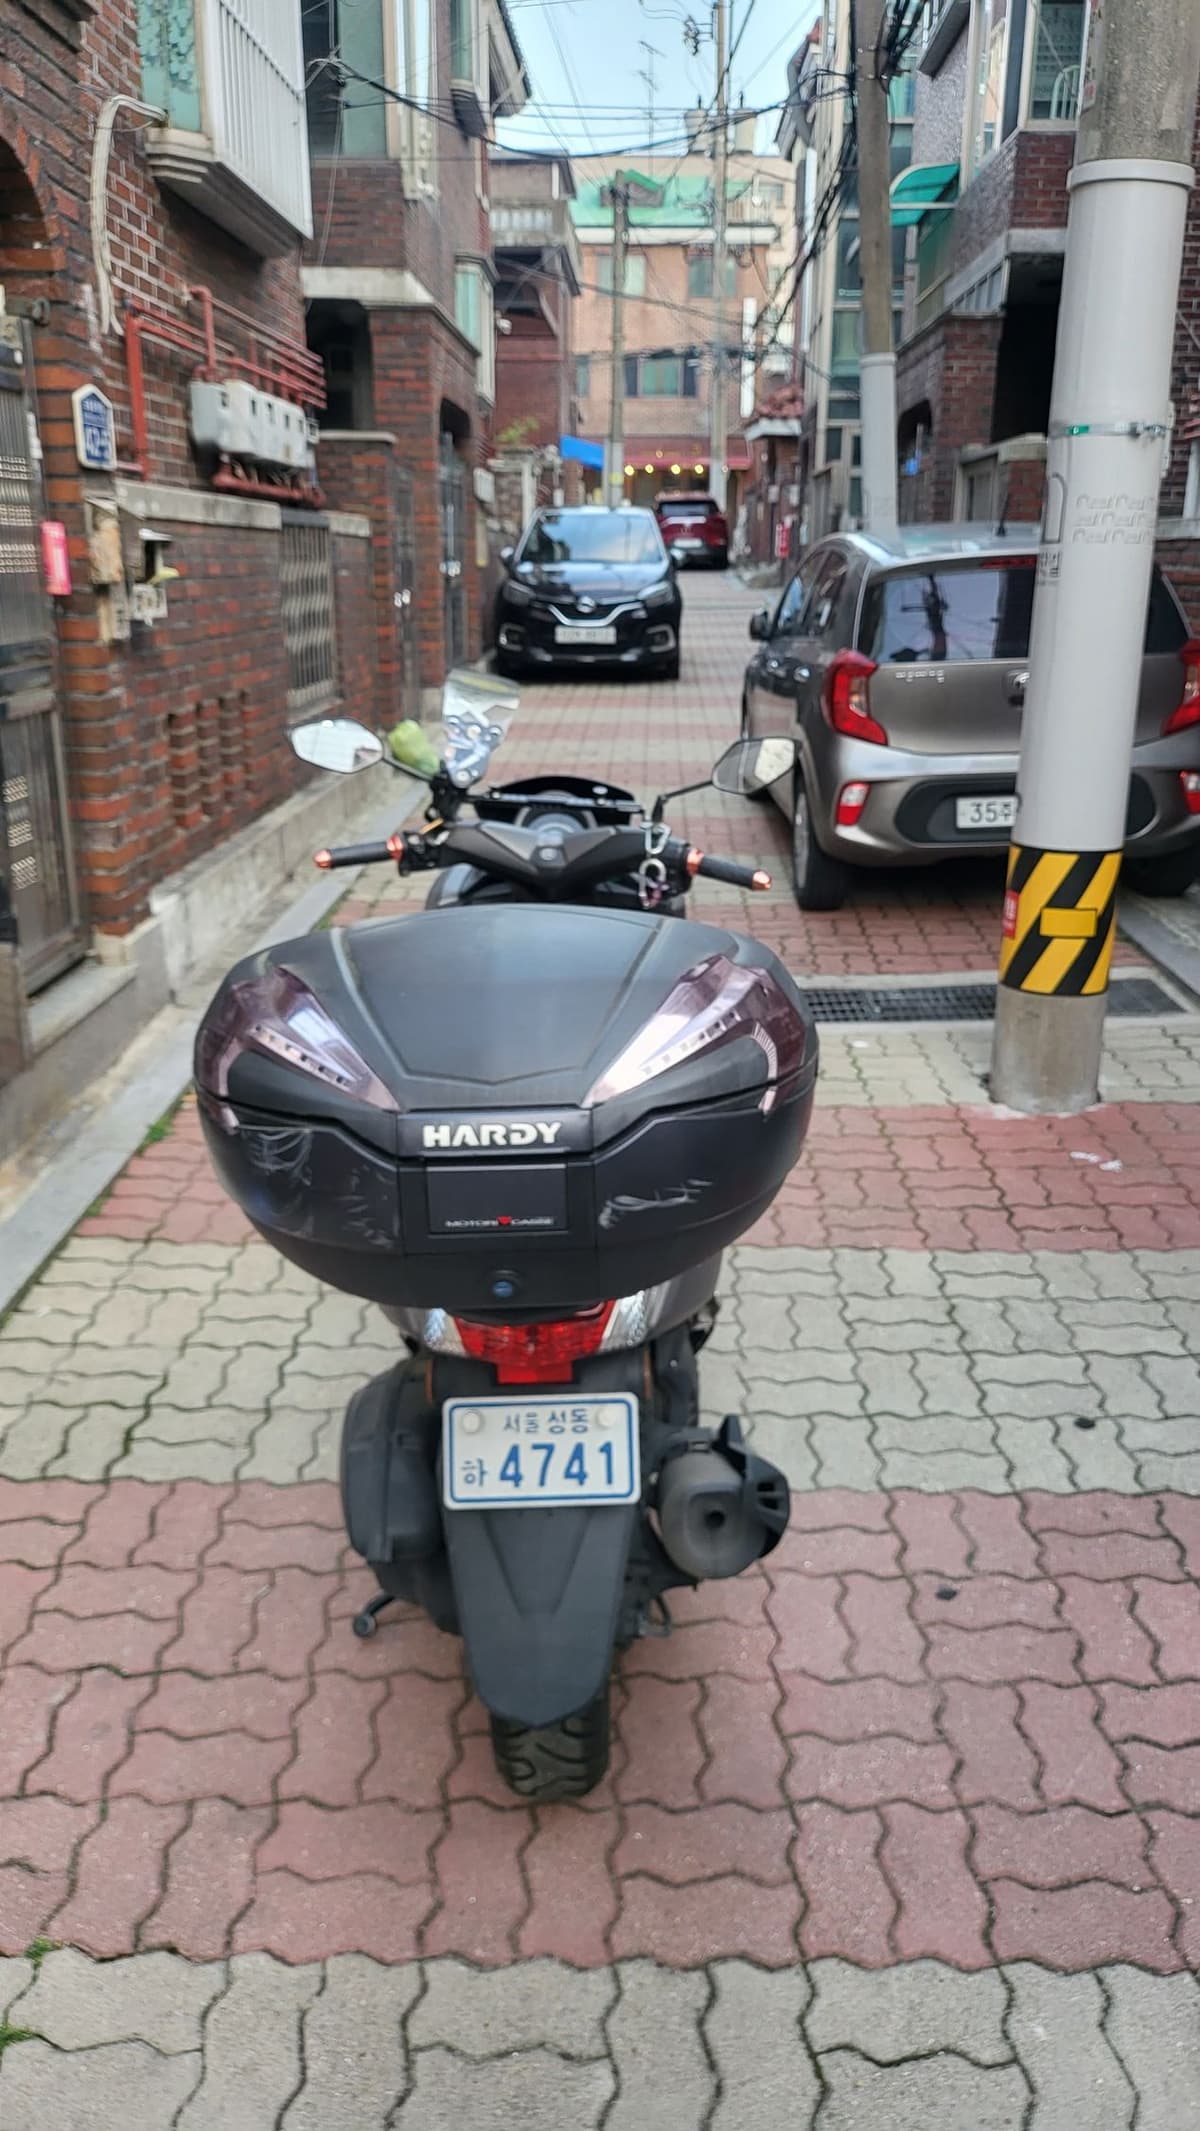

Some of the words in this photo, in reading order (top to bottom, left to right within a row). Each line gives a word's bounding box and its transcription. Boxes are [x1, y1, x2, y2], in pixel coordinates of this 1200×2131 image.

[422, 1122, 562, 1147] HARDY
[503, 1411, 540, 1433] 서울
[547, 1408, 589, 1434] 성동
[461, 1457, 488, 1487] 하
[499, 1440, 615, 1488] 4741
